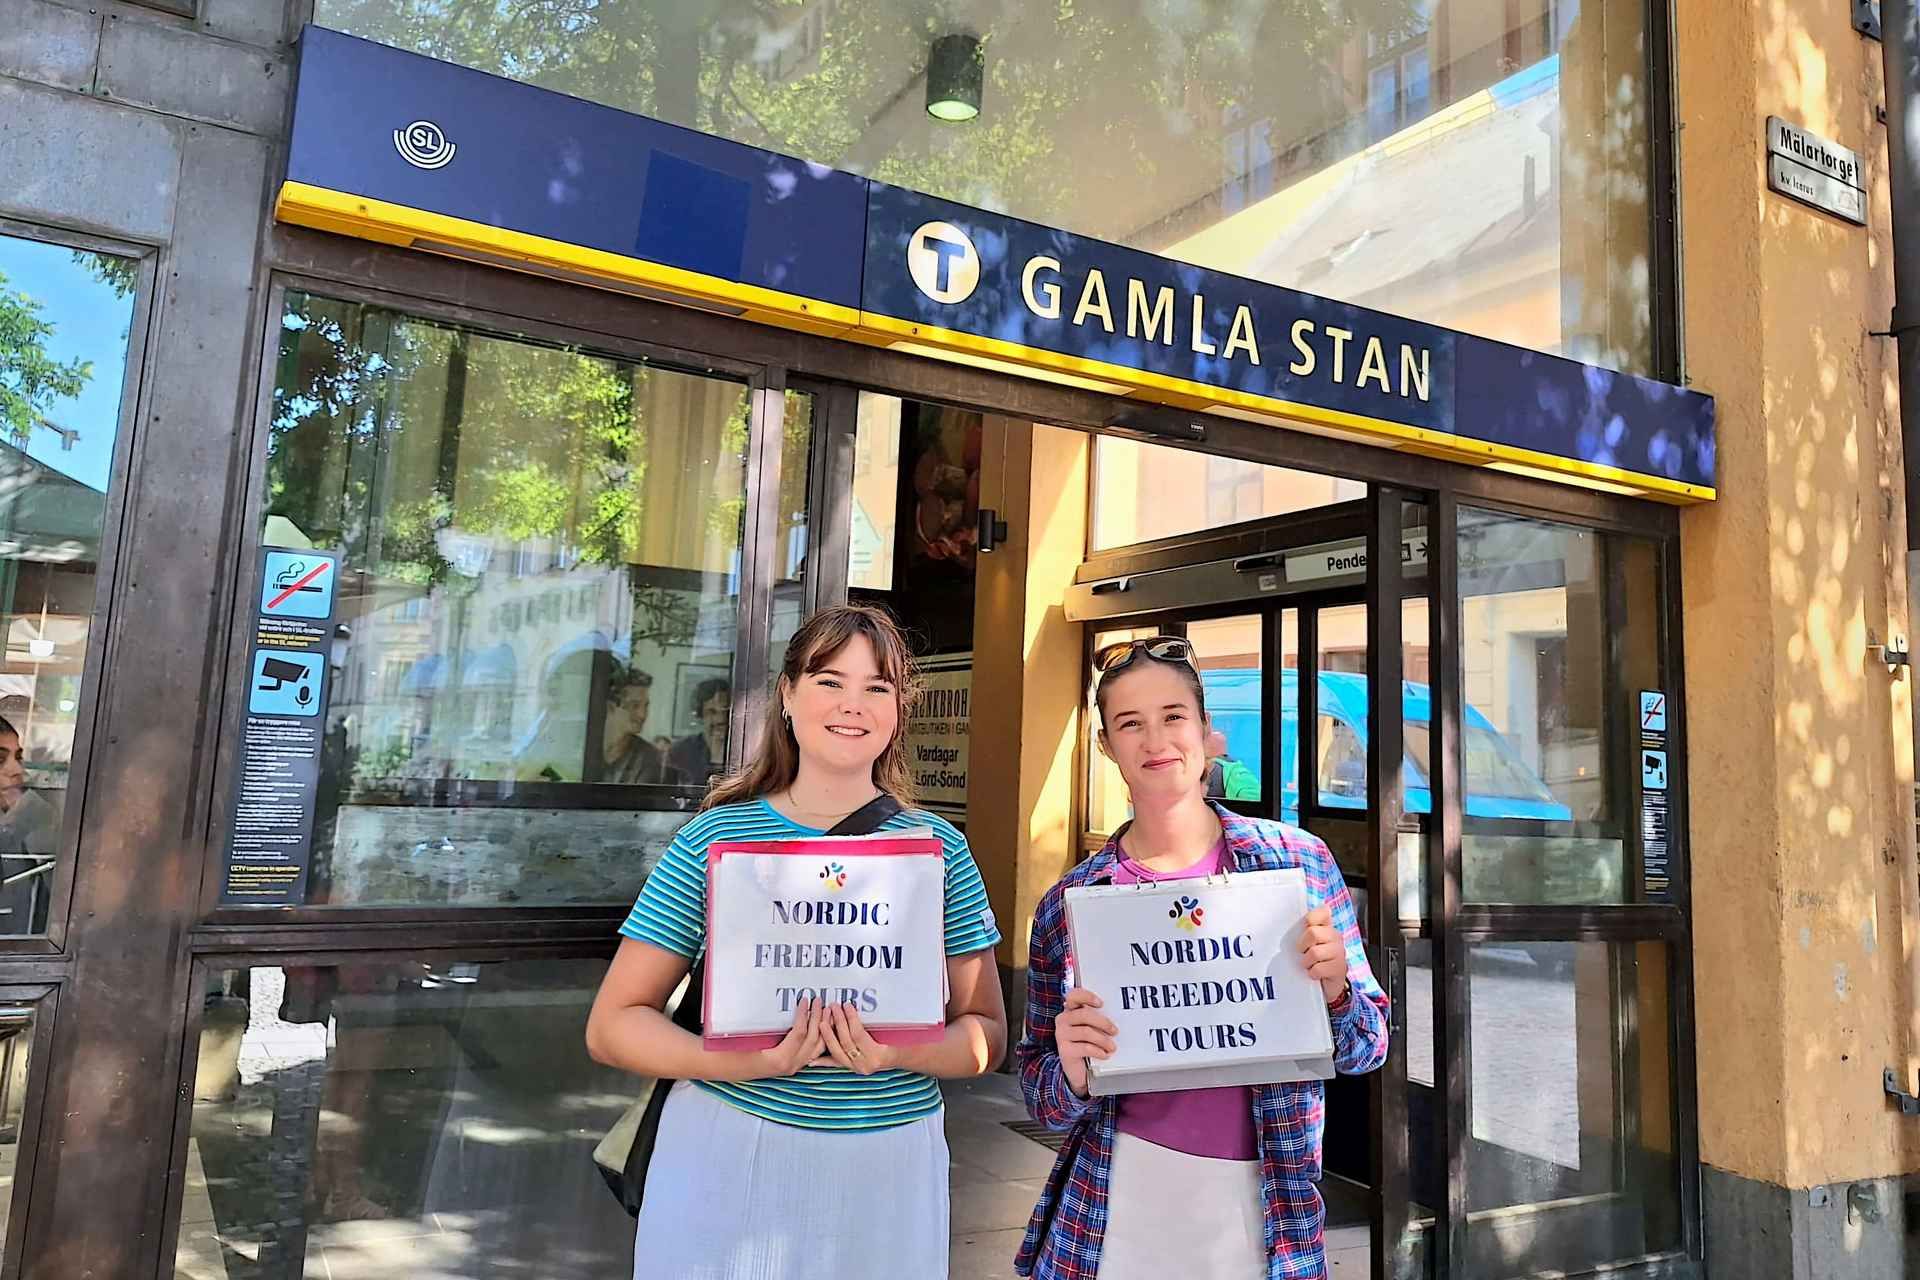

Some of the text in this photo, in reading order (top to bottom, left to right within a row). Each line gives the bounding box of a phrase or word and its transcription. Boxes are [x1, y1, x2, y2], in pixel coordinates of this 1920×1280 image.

[411, 128, 438, 151] SL
[1780, 126, 1859, 182] Mälartorget
[923, 235, 1430, 402] T GAMLA STAN
[1327, 552, 1368, 572] Pende
[916, 744, 959, 766] Vardagar
[771, 900, 890, 926] NORDIC
[754, 943, 903, 970] FREEDOM
[1129, 934, 1254, 967] NORDIC
[776, 987, 879, 1013] TOURS
[1119, 975, 1277, 1010] FREEDOM
[1149, 1022, 1257, 1053] TOURS
